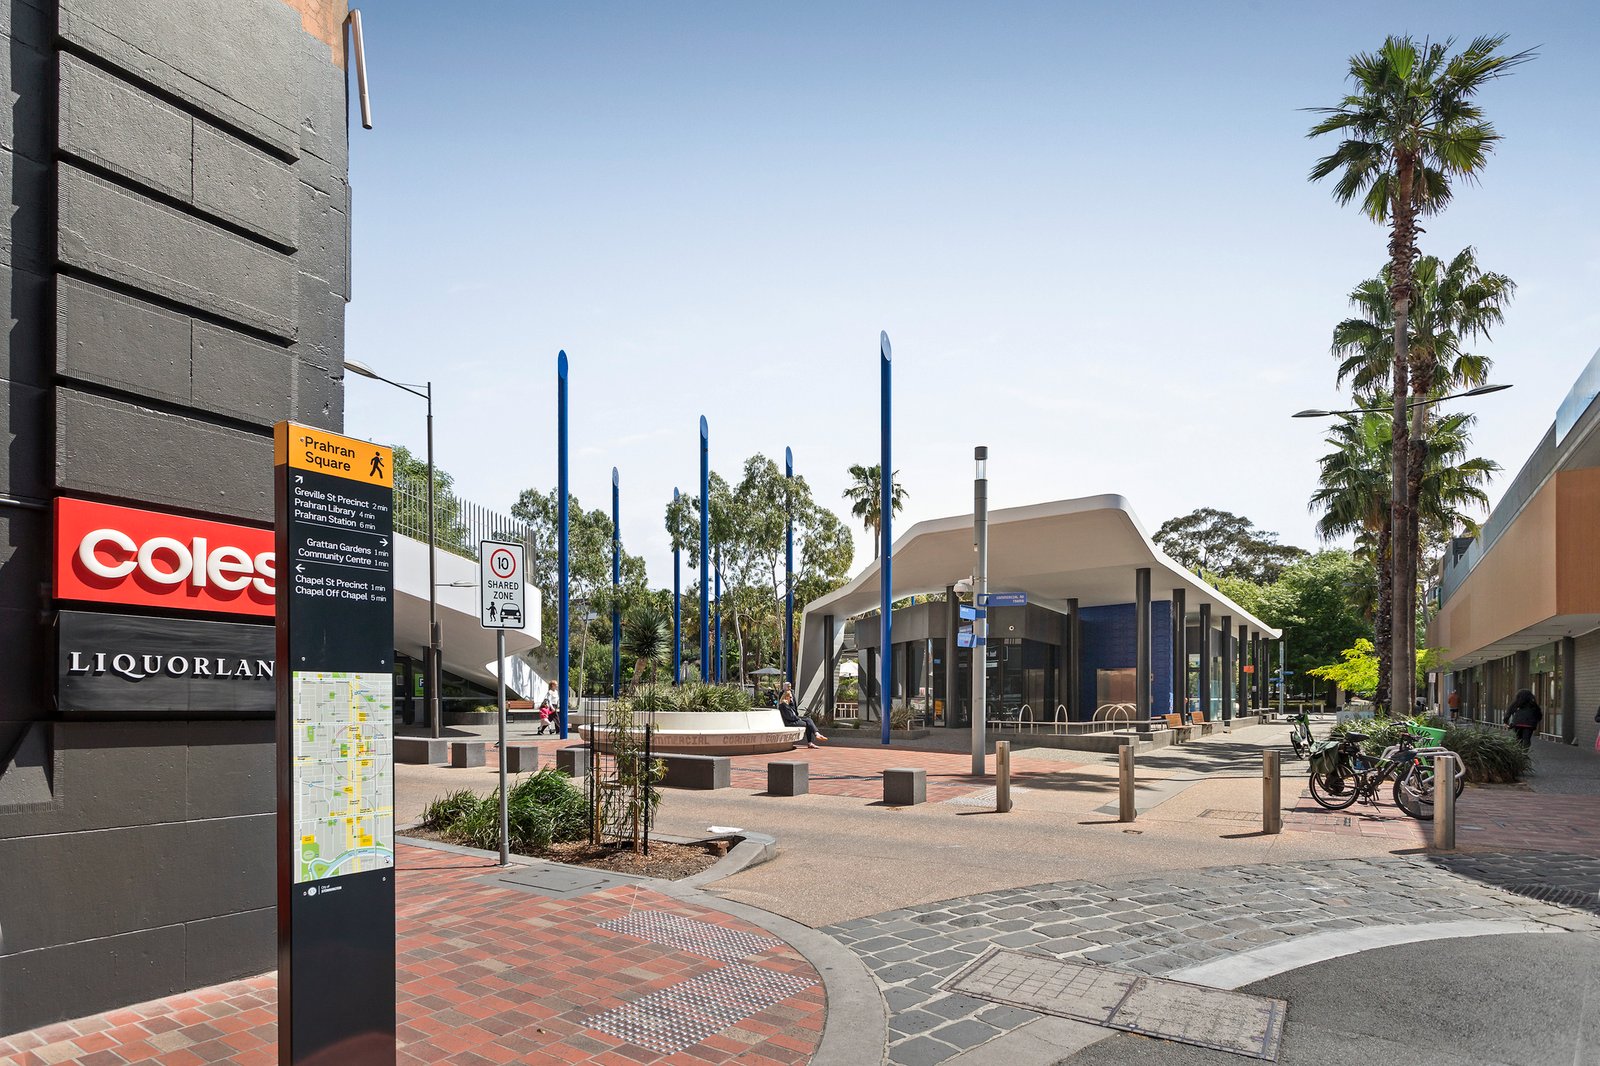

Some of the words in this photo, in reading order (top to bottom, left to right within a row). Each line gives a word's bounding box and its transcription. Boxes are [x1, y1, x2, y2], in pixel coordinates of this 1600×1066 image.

[305, 436, 355, 458] Prahran
[305, 451, 351, 471] Square
[294, 487, 325, 500] Greville
[327, 493, 336, 502] St
[338, 496, 369, 508] Precinct
[294, 498, 327, 511] Prahran
[328, 504, 356, 517] Library
[294, 509, 327, 522] Prahran
[328, 515, 356, 527] Station
[307, 538, 338, 550] Grattan
[340, 543, 372, 555] Gardens
[79, 528, 275, 595] coles
[298, 548, 344, 563] Community
[346, 554, 371, 565] Centre
[497, 557, 509, 570] 10
[295, 574, 324, 586] Chapel
[325, 577, 335, 587] St
[336, 580, 368, 590] Precinct
[488, 580, 519, 590] SHARED
[295, 585, 324, 597] Chapel
[325, 588, 340, 597] Off
[341, 590, 368, 601] Chapel
[493, 591, 514, 600] ZONE
[70, 651, 275, 678] LIQUORLAN
